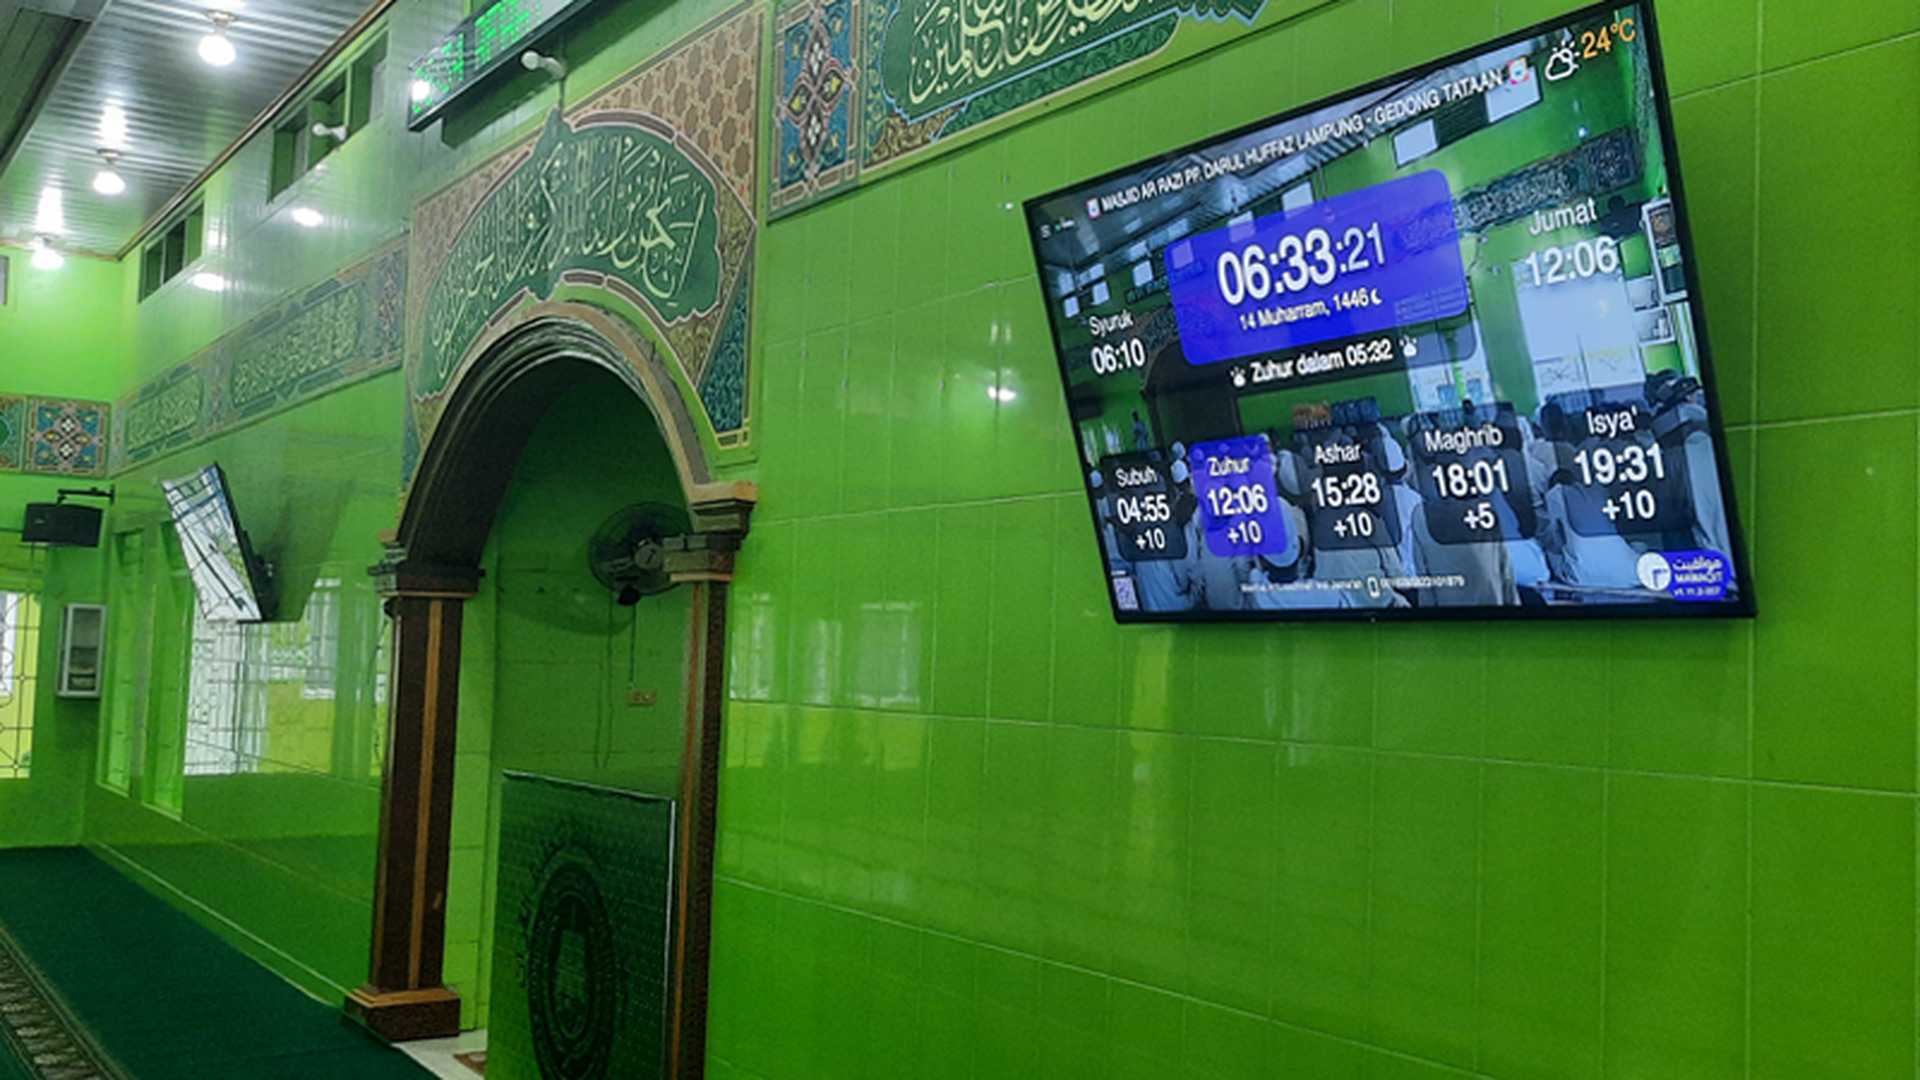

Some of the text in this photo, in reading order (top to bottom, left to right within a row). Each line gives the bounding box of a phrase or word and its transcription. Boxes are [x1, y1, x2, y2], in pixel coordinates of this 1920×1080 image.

[1581, 18, 1636, 59] 24°C
[1101, 186, 1140, 212] MASJID
[1141, 180, 1157, 200] AR
[1158, 172, 1184, 195] RAZI
[1203, 154, 1245, 180] DARUL
[1245, 136, 1295, 166] HUFFAZ
[1296, 113, 1363, 149] LAMPUNG
[1374, 88, 1440, 126] GEDONG
[1441, 69, 1503, 102] TATAAN
[1529, 197, 1598, 236] Jumat
[1218, 221, 1386, 306] 06:33:21
[1525, 235, 1619, 288] 12:06
[1089, 309, 1133, 338] Syuruk
[1238, 313, 1258, 331] 14
[1332, 287, 1370, 312] 1446
[1091, 338, 1146, 376] 06:10
[1250, 338, 1394, 384] Zuhur dalam 05:32
[1425, 422, 1503, 454] Maghrib
[1586, 404, 1638, 439] Isya'
[1207, 456, 1250, 477] Zuhur
[1314, 443, 1361, 465] Ashar
[1574, 443, 1666, 486] 19:31
[1115, 466, 1158, 488] Subuh
[1311, 472, 1381, 508] 15:28
[1432, 458, 1510, 498] 18:01
[1116, 494, 1170, 524] 04:55
[1207, 484, 1268, 516] 12:06
[1463, 502, 1495, 530] +5
[1602, 489, 1655, 521] +10
[1135, 527, 1166, 550] +10
[1227, 520, 1262, 544] +10
[1334, 512, 1373, 538] +10
